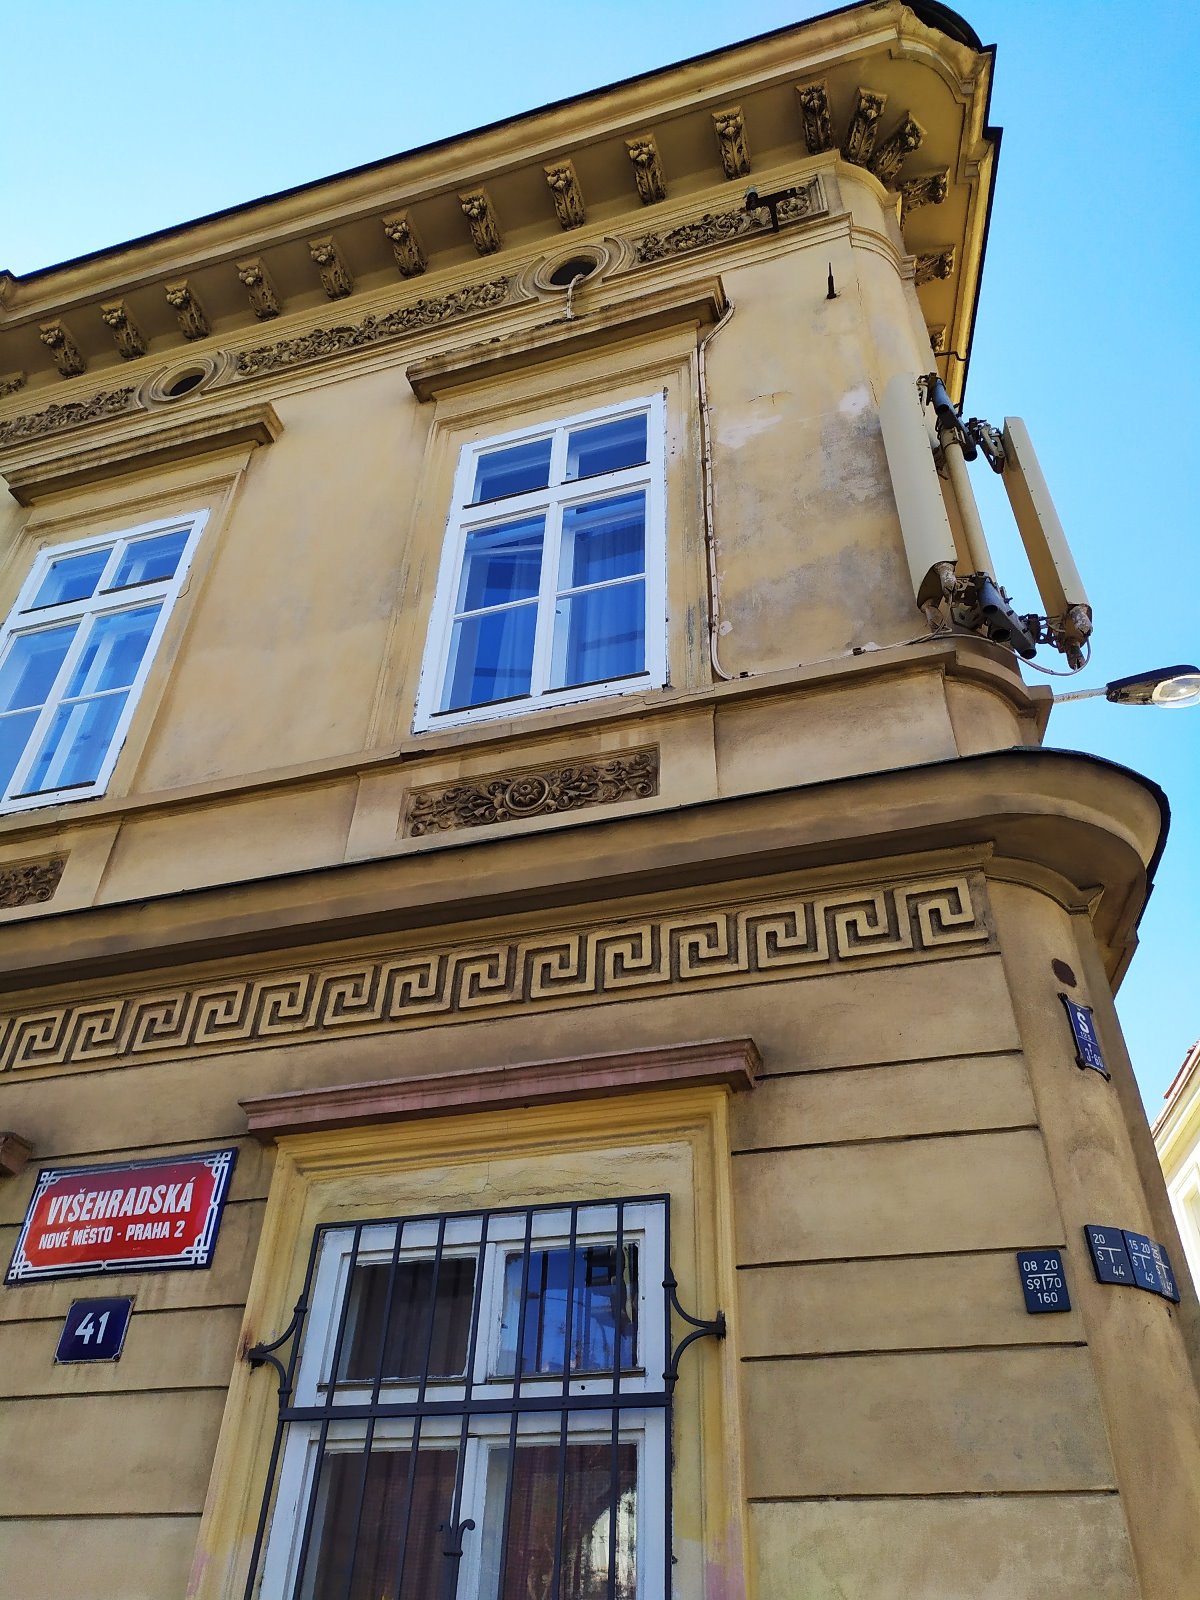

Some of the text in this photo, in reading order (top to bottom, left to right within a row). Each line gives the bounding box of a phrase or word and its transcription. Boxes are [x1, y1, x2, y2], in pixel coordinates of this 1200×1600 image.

[46, 1176, 196, 1226] VYŠEHRADSKÁ
[38, 1227, 71, 1250] NOVÉ
[71, 1225, 113, 1246] MĚSTO
[125, 1222, 170, 1242] PRAHA
[174, 1220, 186, 1238] 2
[1092, 1233, 1106, 1244] 20
[1128, 1239, 1139, 1251] 15
[1140, 1242, 1151, 1254] 20
[1097, 1250, 1104, 1261] S
[1023, 1259, 1059, 1272] 08 20
[1112, 1265, 1125, 1277] 44
[1046, 1277, 1062, 1289] 70
[1145, 1271, 1155, 1284] 42
[1037, 1291, 1059, 1304] 160
[74, 1310, 110, 1345] 41
